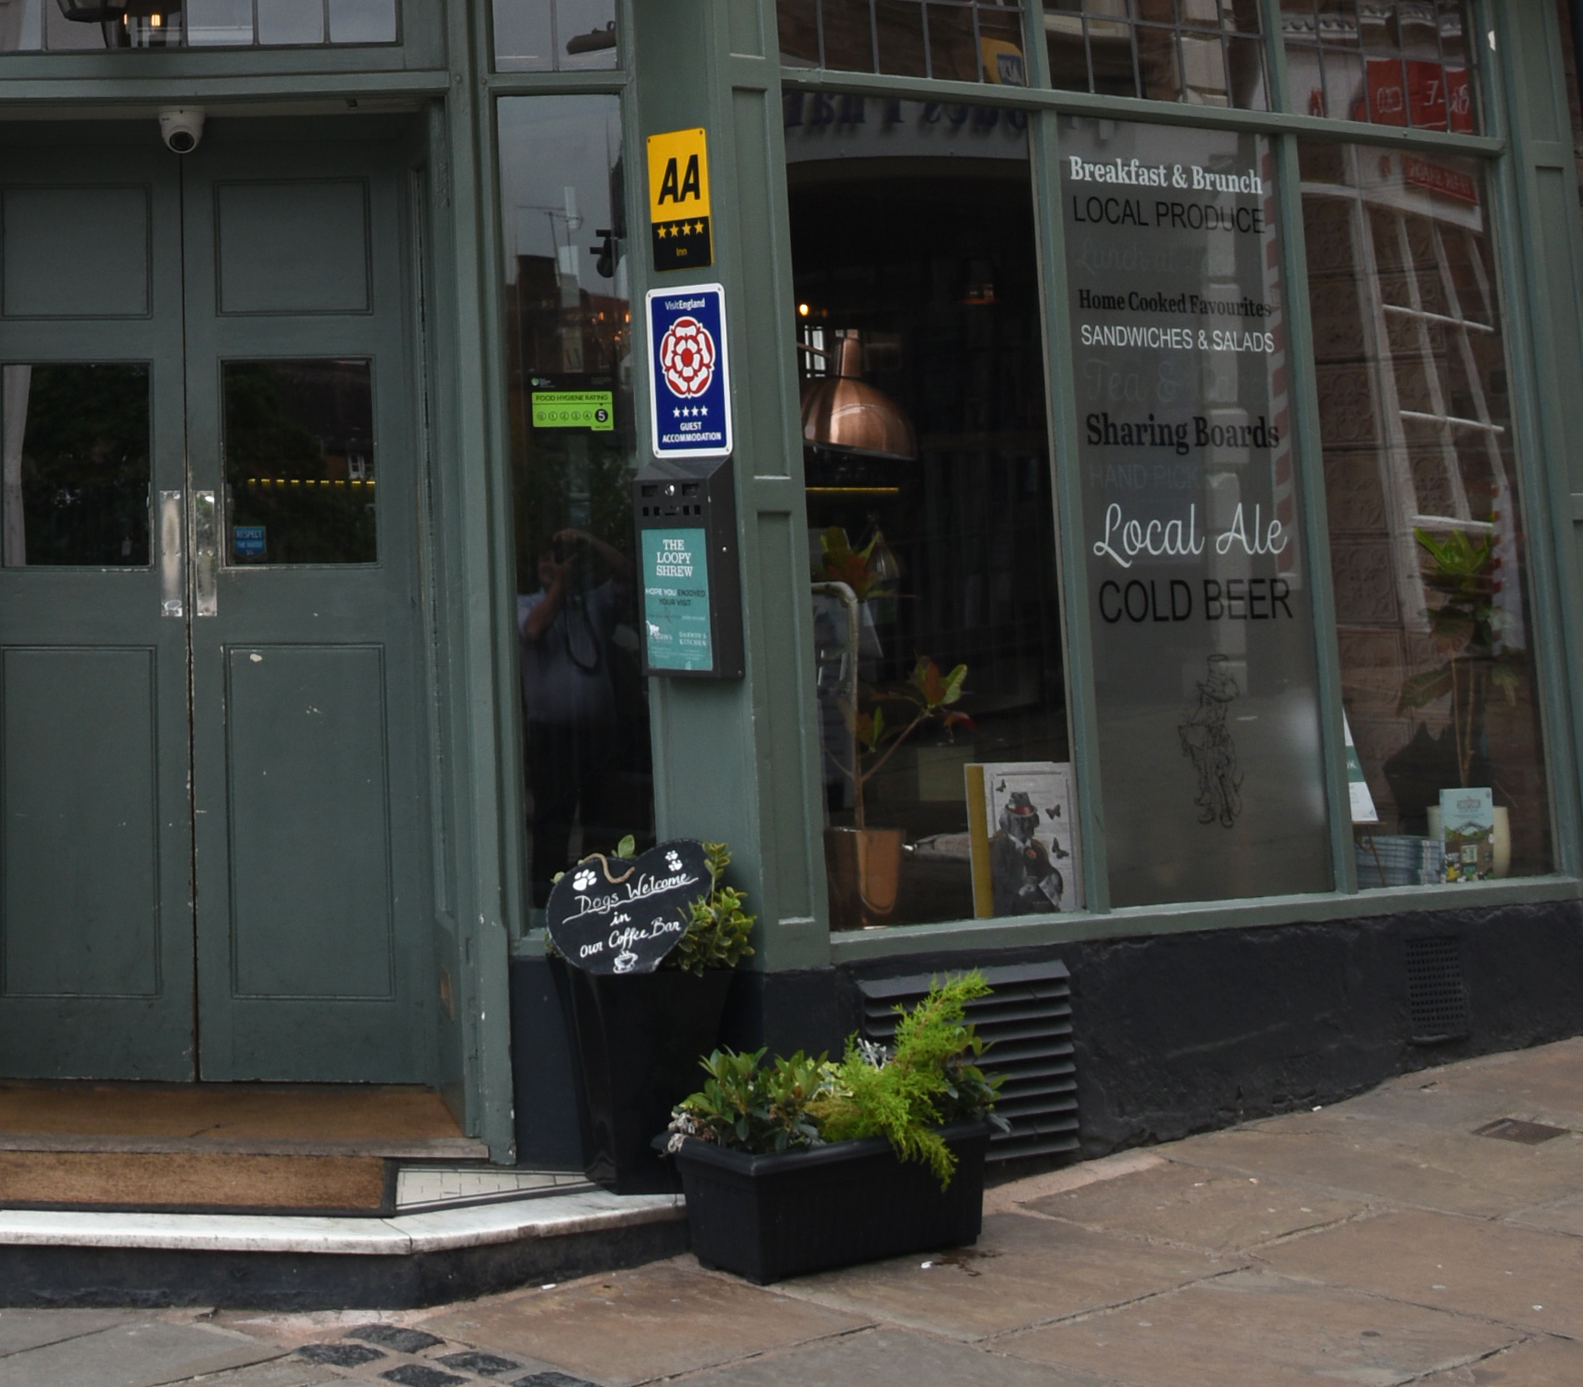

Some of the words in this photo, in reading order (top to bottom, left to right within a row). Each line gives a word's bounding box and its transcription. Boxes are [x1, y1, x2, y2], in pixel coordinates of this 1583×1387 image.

[657, 154, 701, 205] AA
[1069, 156, 1168, 187] Breakfast
[1172, 164, 1189, 189] &
[1191, 165, 1263, 194] Brunch
[1073, 195, 1149, 226] LOCAL
[1156, 201, 1266, 234] PRODUCE
[676, 248, 687, 256] Inn
[665, 298, 706, 311] VisitEngland
[1078, 289, 1125, 310] Home
[1128, 291, 1186, 313] Cooked
[1189, 295, 1272, 317] Favourites
[1081, 324, 1193, 349] SANDWICHES
[1197, 329, 1209, 350] &
[1213, 330, 1275, 353] SALADS
[598, 411, 605, 421] 5
[680, 422, 702, 431] GUEST
[1086, 412, 1189, 455] Sharing
[1193, 415, 1280, 449] Boards
[662, 432, 722, 443] ACCOMMODATION
[236, 530, 262, 538] RESPECT
[1093, 503, 1205, 568] Local
[1216, 502, 1288, 555] Ale
[663, 539, 684, 551] THE
[656, 552, 691, 564] LOOPY
[656, 565, 693, 577] SHREW
[645, 587, 663, 596] HOPE
[664, 588, 677, 596] YOU
[1099, 580, 1192, 623] COLD
[1203, 579, 1293, 620] BEER
[575, 893, 619, 914] Dogs
[626, 873, 691, 899] Welcome
[610, 912, 631, 926] in
[580, 941, 604, 958] our
[608, 927, 649, 949] Coffee
[648, 917, 681, 939] Bar
